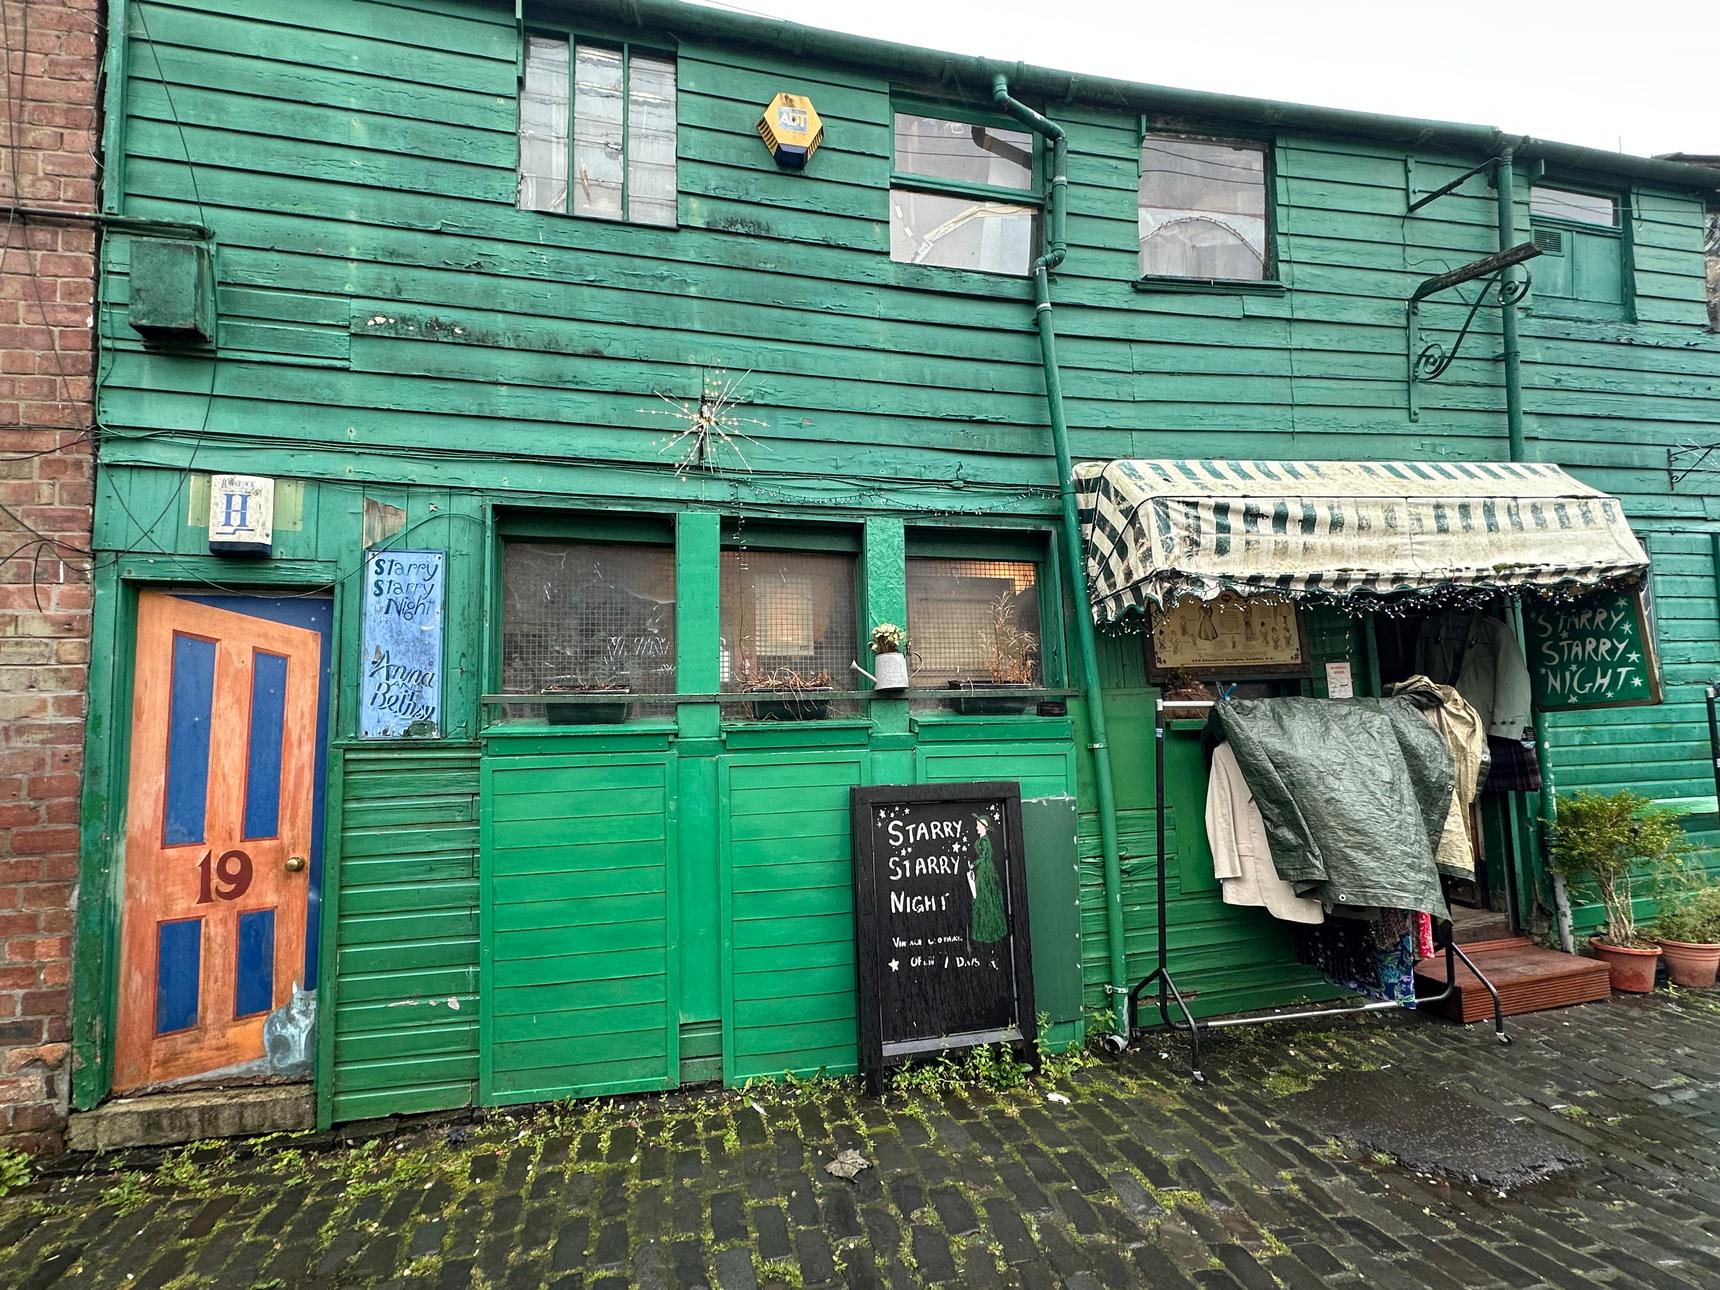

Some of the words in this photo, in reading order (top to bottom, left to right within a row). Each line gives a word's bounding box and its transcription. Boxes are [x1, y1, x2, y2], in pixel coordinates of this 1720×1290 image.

[779, 111, 807, 128] ADT
[375, 559, 438, 581] Starry
[373, 580, 434, 600] Starry
[384, 595, 434, 620] Night
[1537, 609, 1625, 638] STARRY
[1542, 638, 1629, 665] STARRY
[369, 650, 435, 688] Anna
[1547, 667, 1635, 694] NIGHT
[888, 820, 962, 846] STARRY
[196, 849, 253, 904] 19
[888, 855, 960, 880] STARRY
[890, 891, 950, 914] NIGHT
